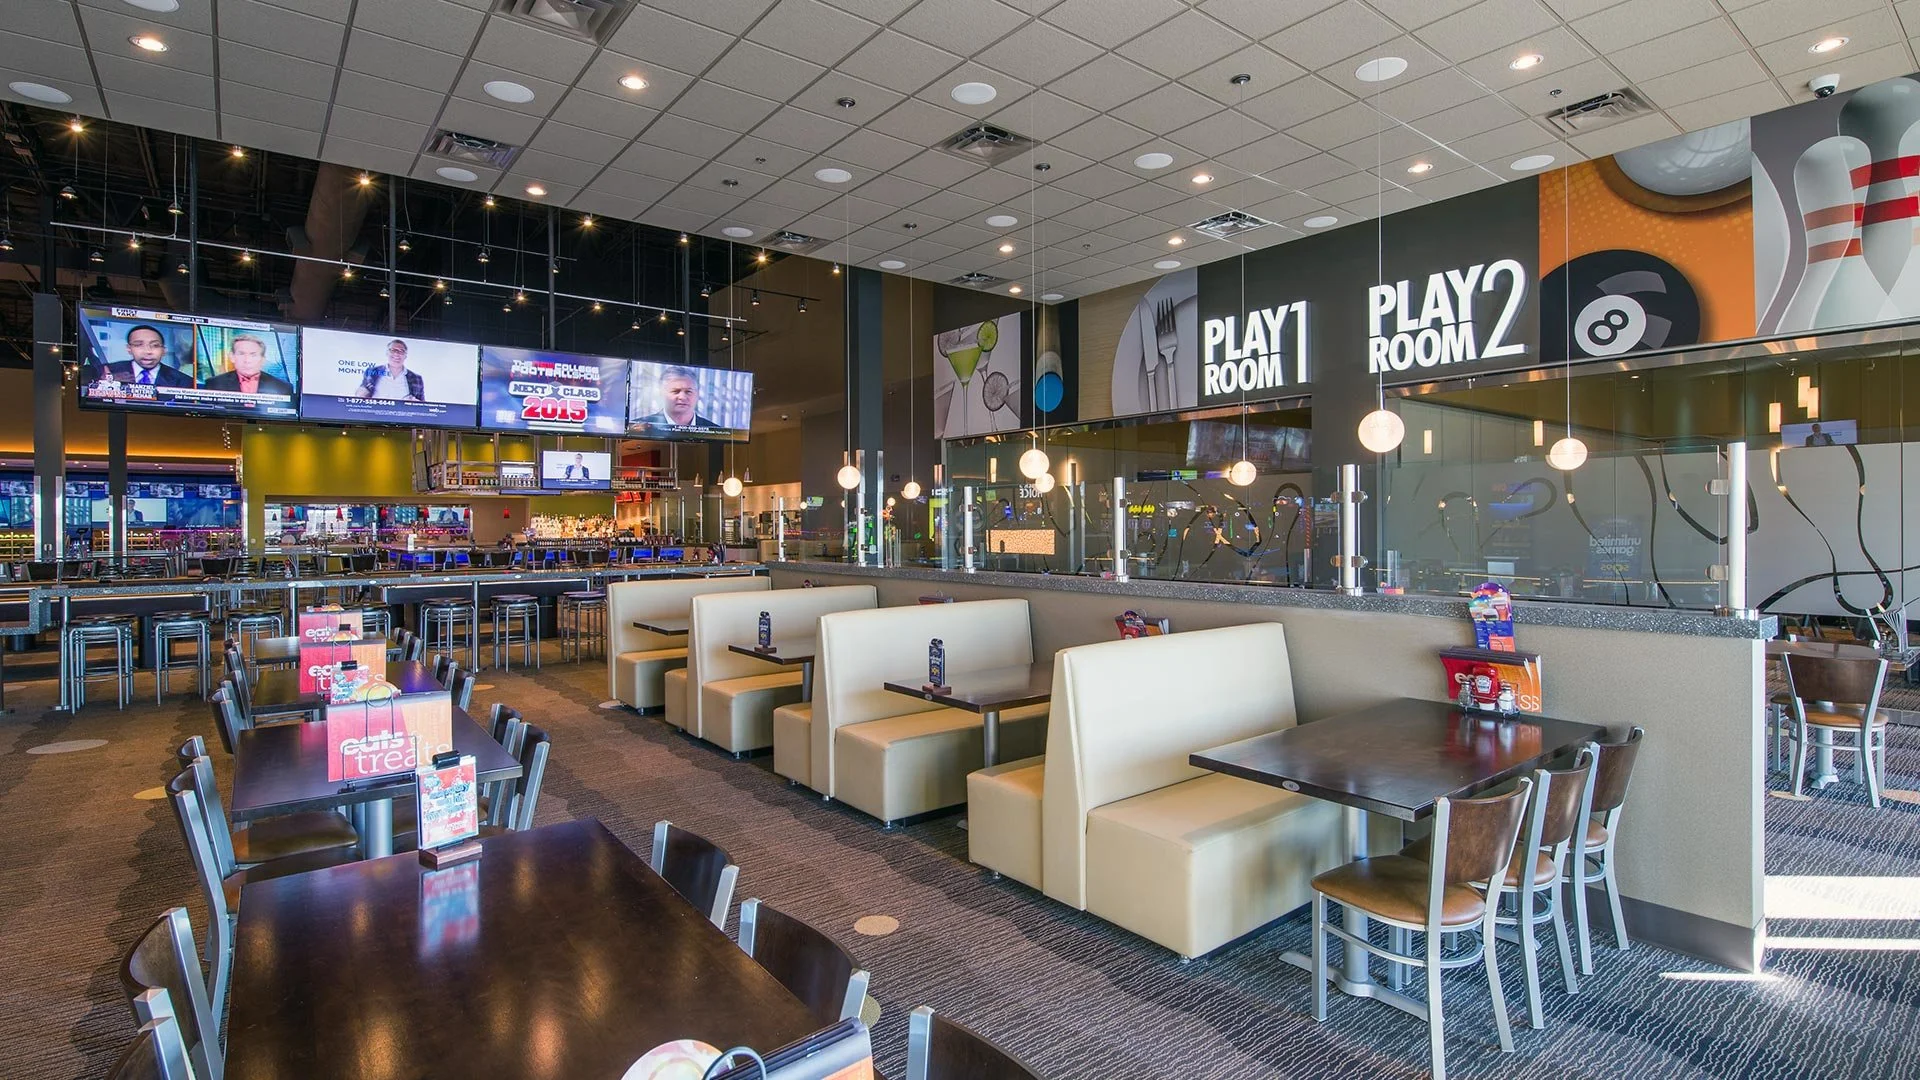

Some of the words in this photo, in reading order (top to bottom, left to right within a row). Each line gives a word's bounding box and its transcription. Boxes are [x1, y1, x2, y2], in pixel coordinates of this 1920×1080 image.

[1369, 264, 1485, 337] PLAY
[1481, 258, 1528, 359] 2
[1587, 309, 1629, 346] 8
[1204, 304, 1290, 364] PLAY
[1289, 300, 1309, 384] 1
[1369, 321, 1479, 374] ROOM
[513, 384, 547, 394] NEXT
[563, 388, 598, 398] CLASS
[1204, 353, 1285, 396] ROOM
[522, 396, 587, 421] 2015
[340, 730, 404, 755] eats
